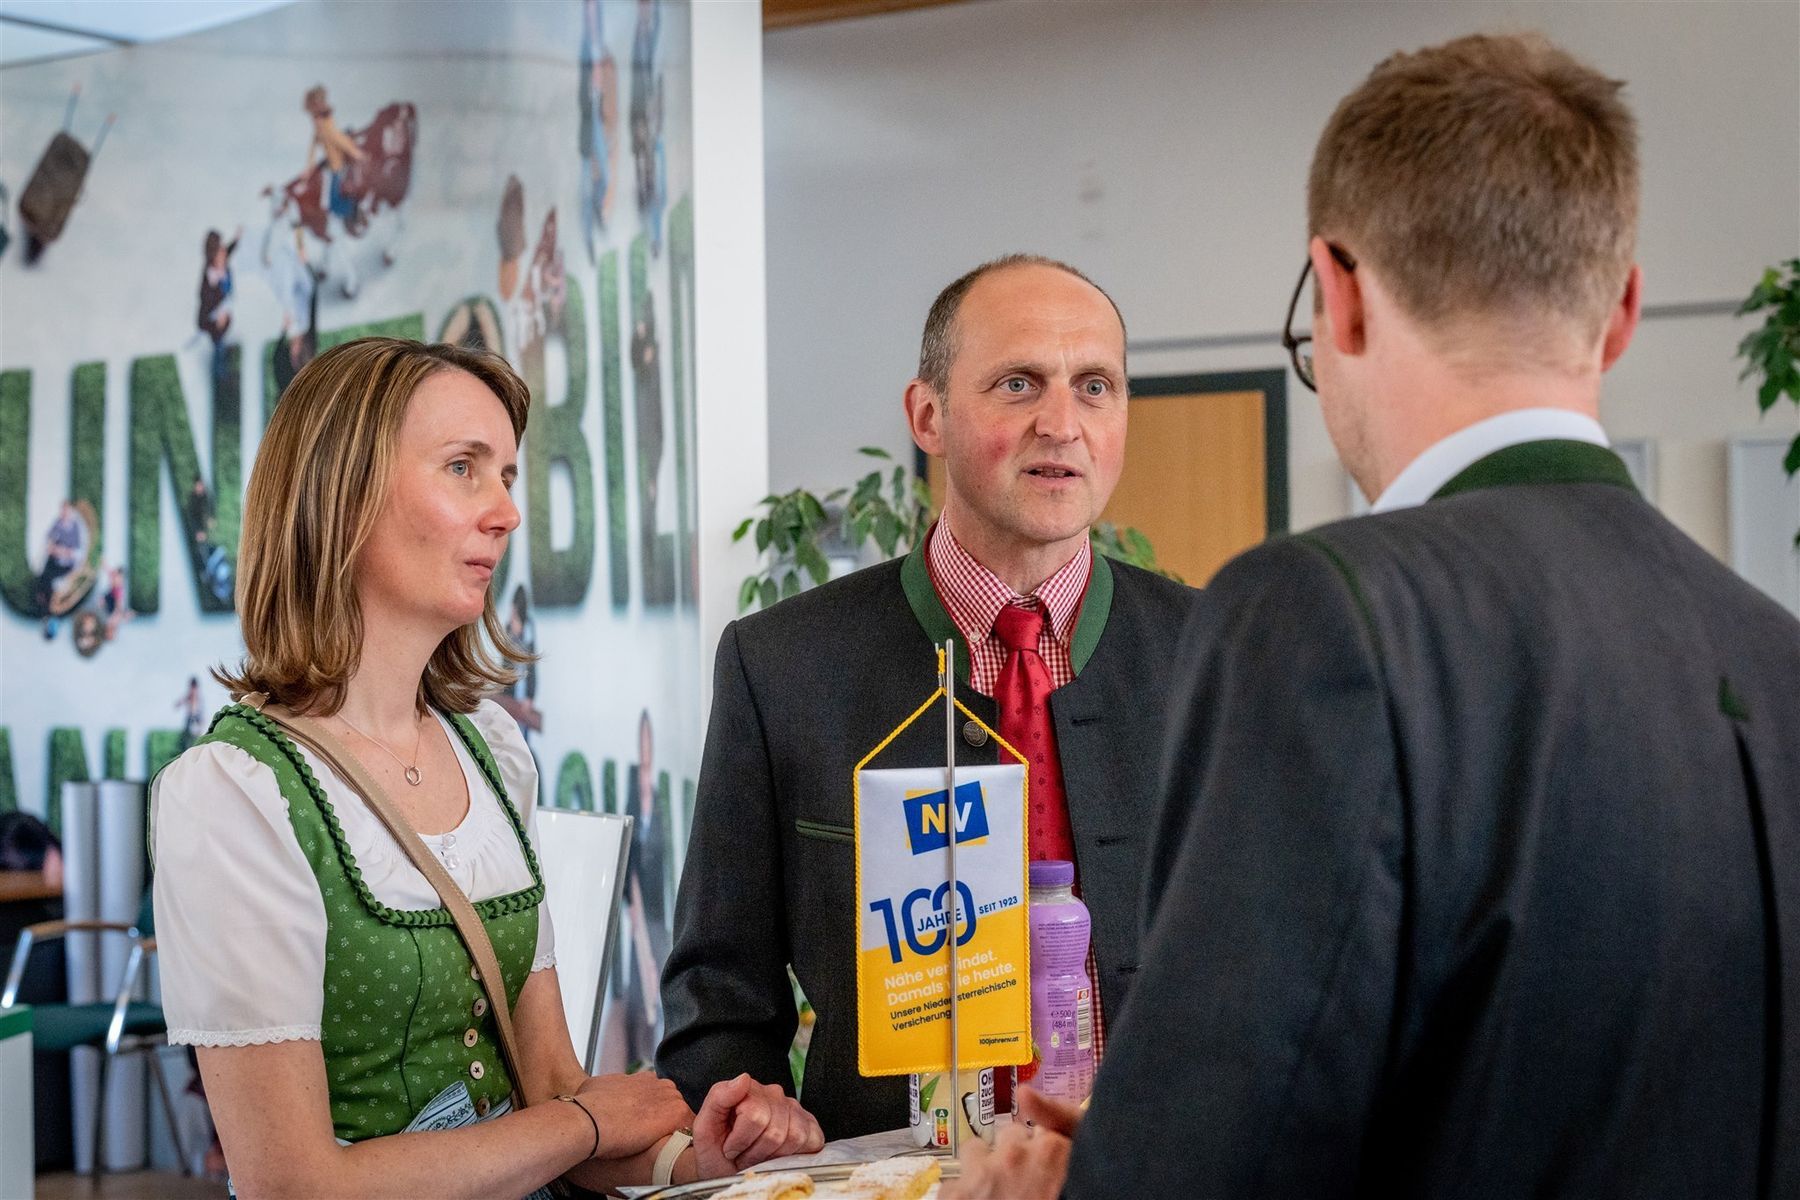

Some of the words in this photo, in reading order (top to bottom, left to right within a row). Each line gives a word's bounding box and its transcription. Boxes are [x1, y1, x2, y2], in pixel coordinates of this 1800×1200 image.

[922, 802, 973, 834] NV
[979, 902, 997, 914] SEIT
[999, 896, 1018, 908] 1923
[870, 880, 977, 964] 100
[884, 970, 924, 990] Nähe
[926, 949, 998, 979] verindet.
[888, 981, 944, 1006] Damals
[973, 962, 1016, 983] heute.
[890, 1006, 922, 1020] Unsere
[923, 978, 1017, 1011] Niedersterreichische
[892, 1009, 952, 1032] Versicherung
[1052, 1020, 1066, 1031] (484
[1060, 1010, 1072, 1018] 500
[979, 1036, 1019, 1047] 100jahrenv.at
[939, 1109, 945, 1117] A
